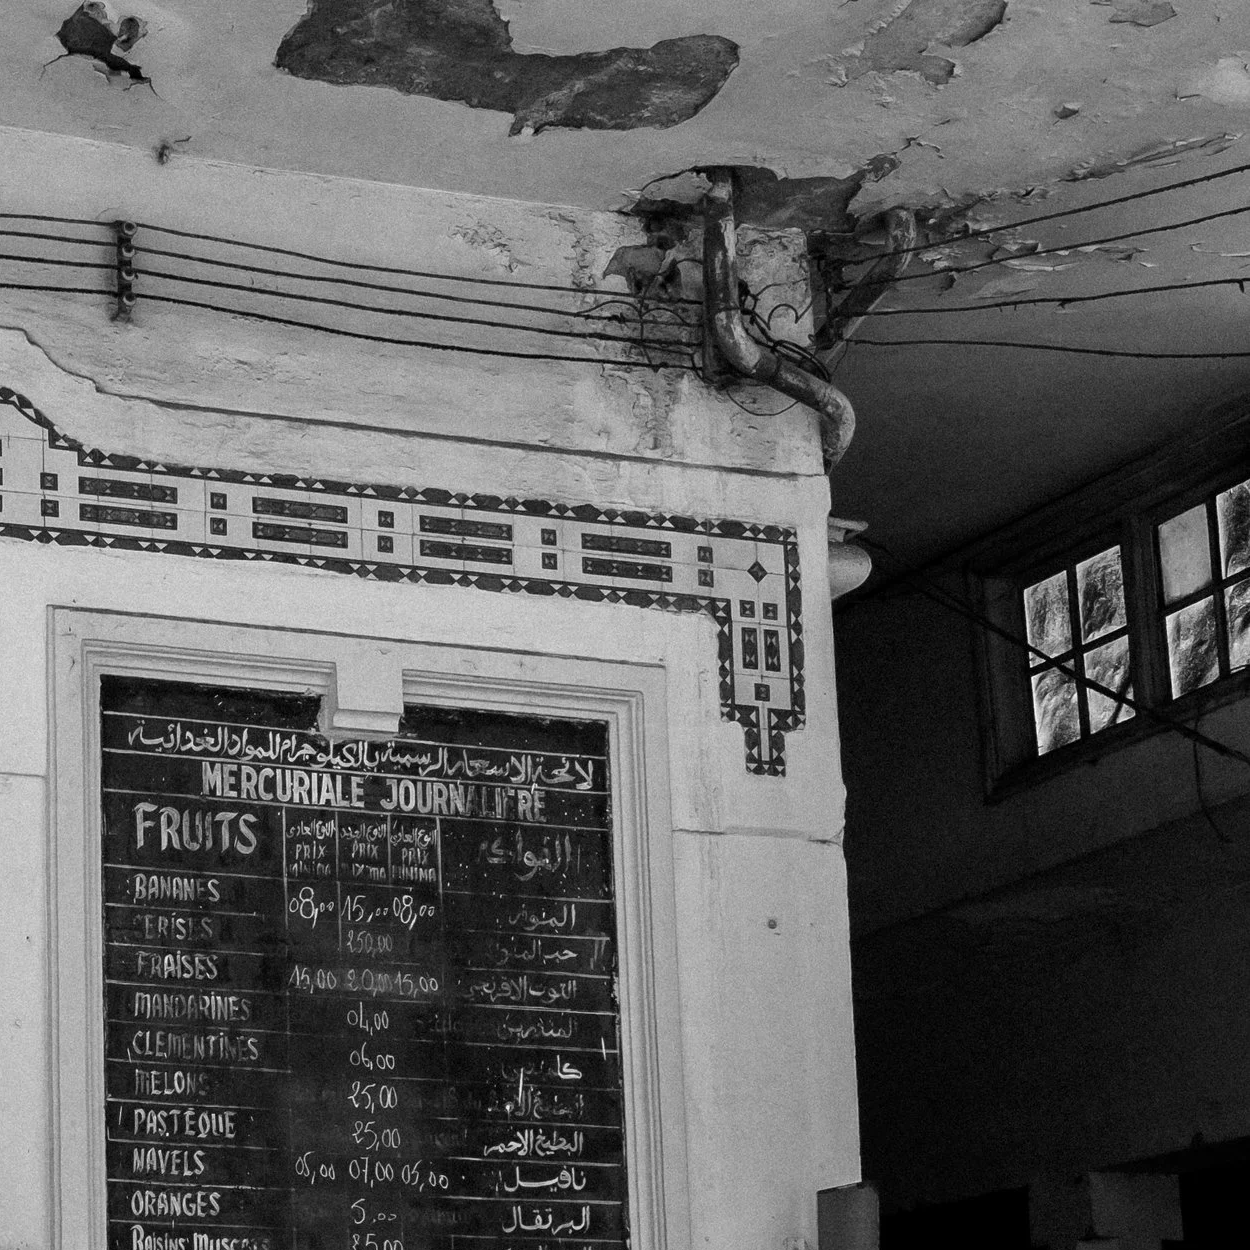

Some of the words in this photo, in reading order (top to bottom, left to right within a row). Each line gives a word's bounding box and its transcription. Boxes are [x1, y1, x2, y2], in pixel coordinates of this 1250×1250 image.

[202, 761, 365, 808] MERCURIALE
[133, 801, 259, 854] FRUITS
[295, 840, 327, 860] PRIX
[351, 839, 379, 860] PRIX
[289, 886, 335, 929] 08,00
[340, 895, 389, 923] 15,00
[393, 894, 436, 931] 08,00
[135, 950, 219, 980] FRAISES
[134, 991, 252, 1021] MANDARINES
[347, 1001, 390, 1037] 04,00
[349, 1041, 396, 1070] 06,00
[132, 1147, 207, 1177] NAVELS
[349, 1156, 395, 1189] 07,00
[130, 1190, 222, 1218] ORANGES
